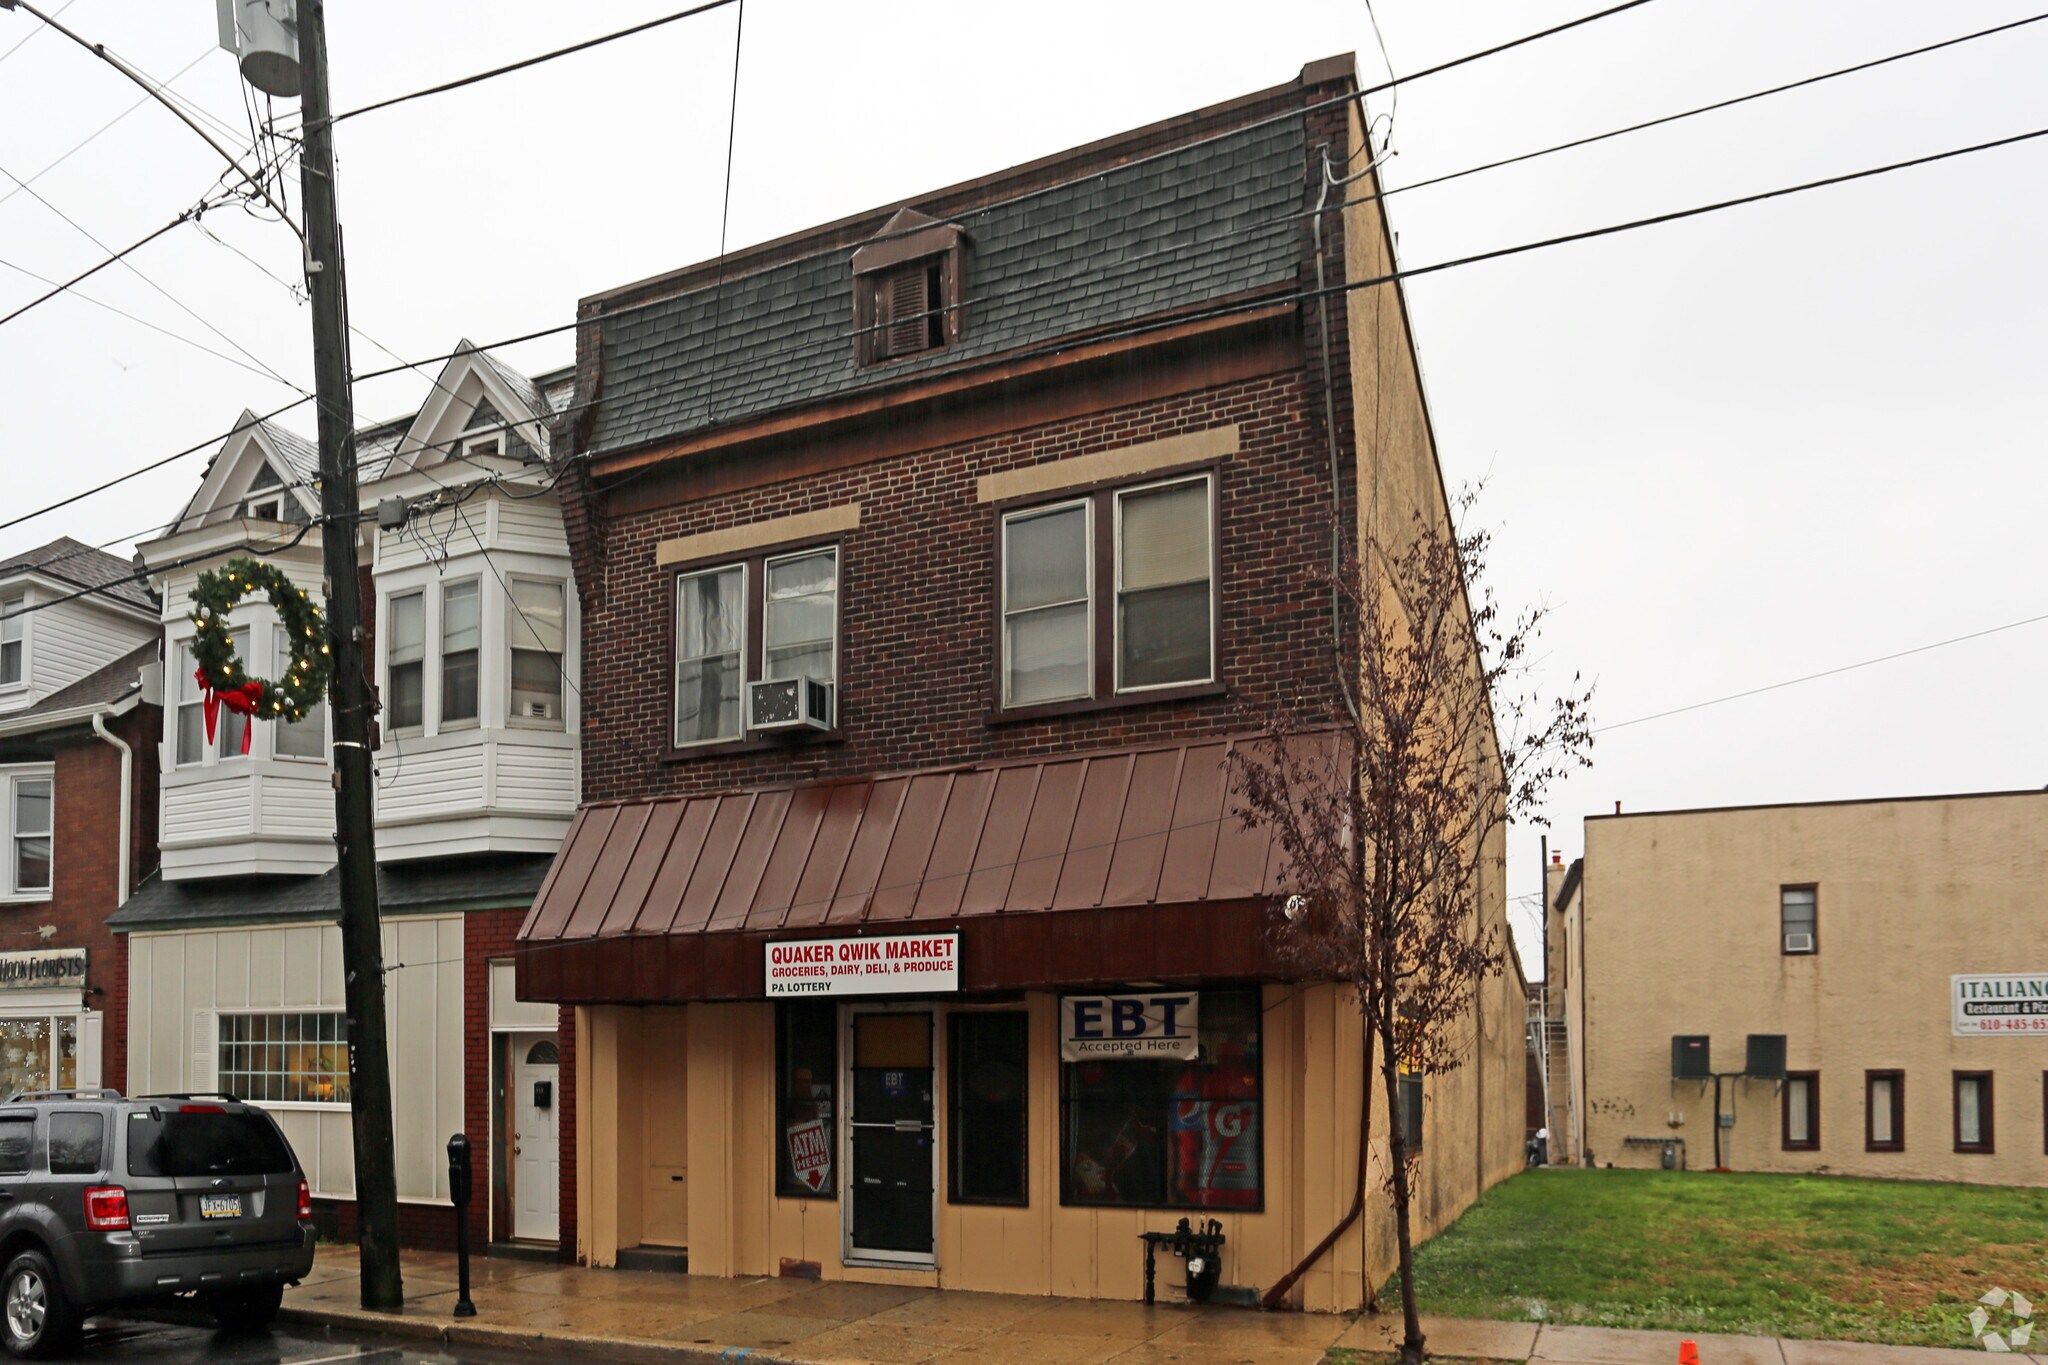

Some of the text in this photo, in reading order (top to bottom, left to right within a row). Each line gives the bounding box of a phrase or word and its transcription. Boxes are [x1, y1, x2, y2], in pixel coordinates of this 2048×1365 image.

[772, 939, 953, 964] QUAKER QWIK MARKET
[29, 957, 81, 980] FLORISTS
[772, 960, 953, 977] GROCERIES, DAIRY, DELI, & PRODUCE
[772, 982, 831, 992] PA LOTTERY
[1074, 997, 1189, 1038] EBT
[1967, 1003, 2020, 1014] Restaurant
[1079, 1040, 1142, 1053] Accepted
[1147, 1039, 1180, 1050] Here
[1215, 1105, 1241, 1137] G
[794, 1131, 825, 1159] ATM
[796, 1153, 828, 1170] HERE
